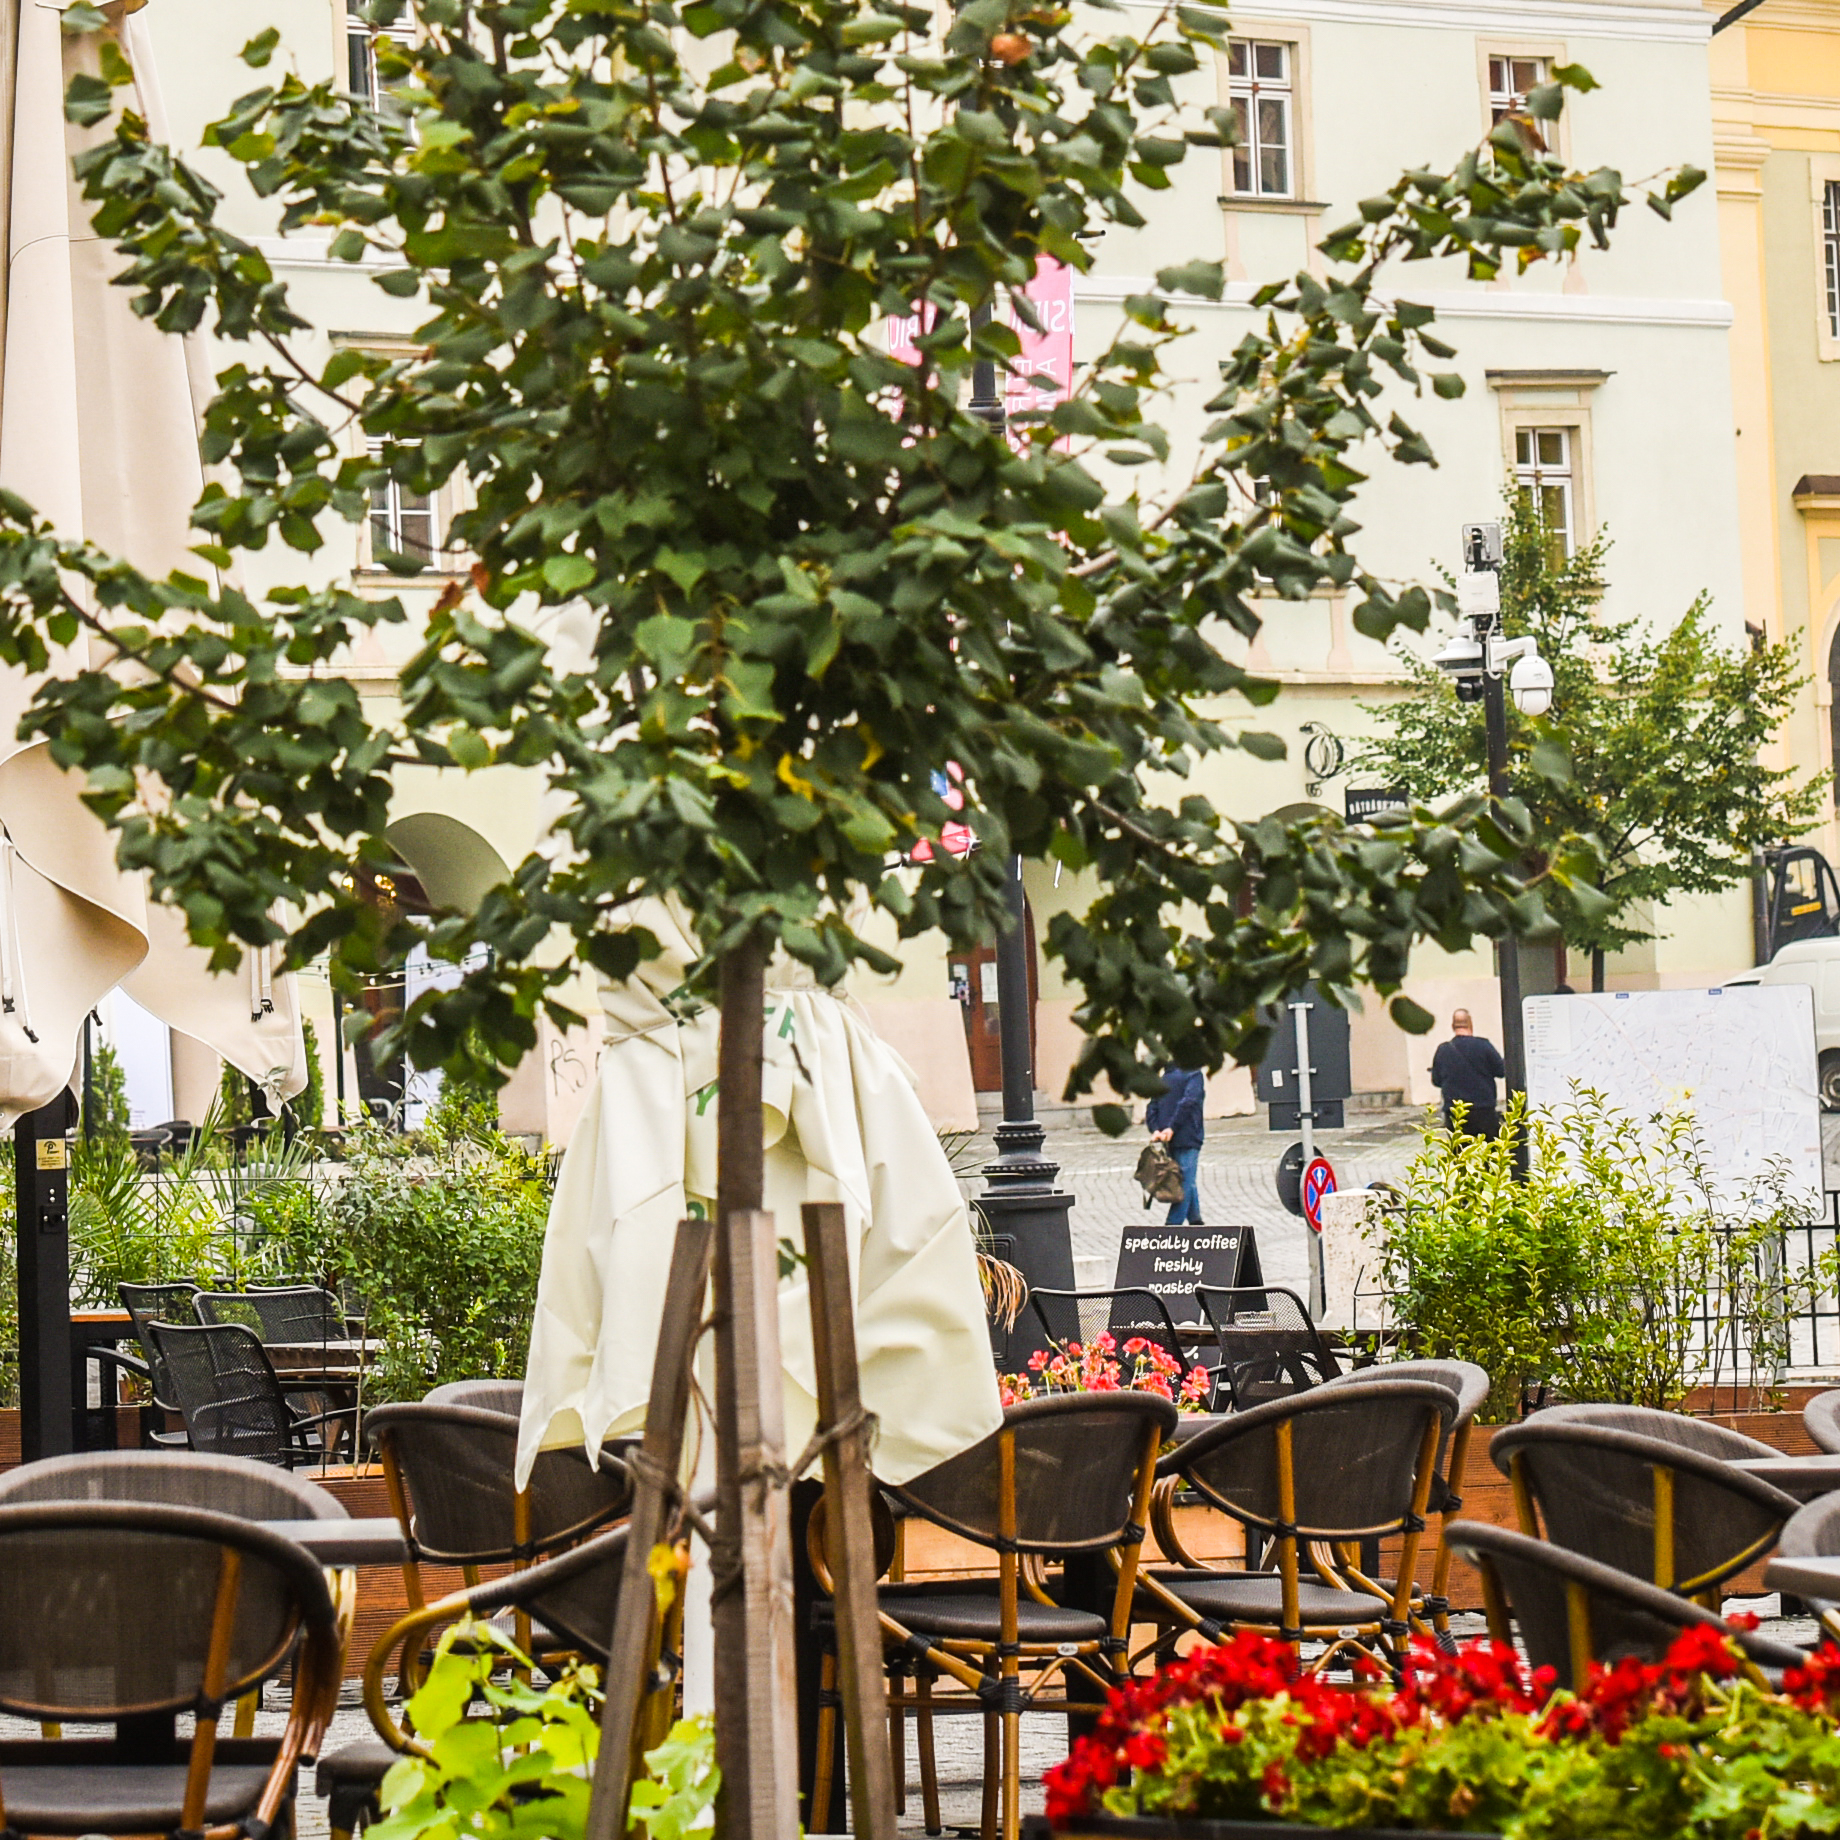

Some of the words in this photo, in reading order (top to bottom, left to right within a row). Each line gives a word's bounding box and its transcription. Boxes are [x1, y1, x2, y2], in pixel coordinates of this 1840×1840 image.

[1125, 1234, 1190, 1253] specialty
[1193, 1234, 1238, 1250] coffee
[1153, 1256, 1204, 1275] freshly
